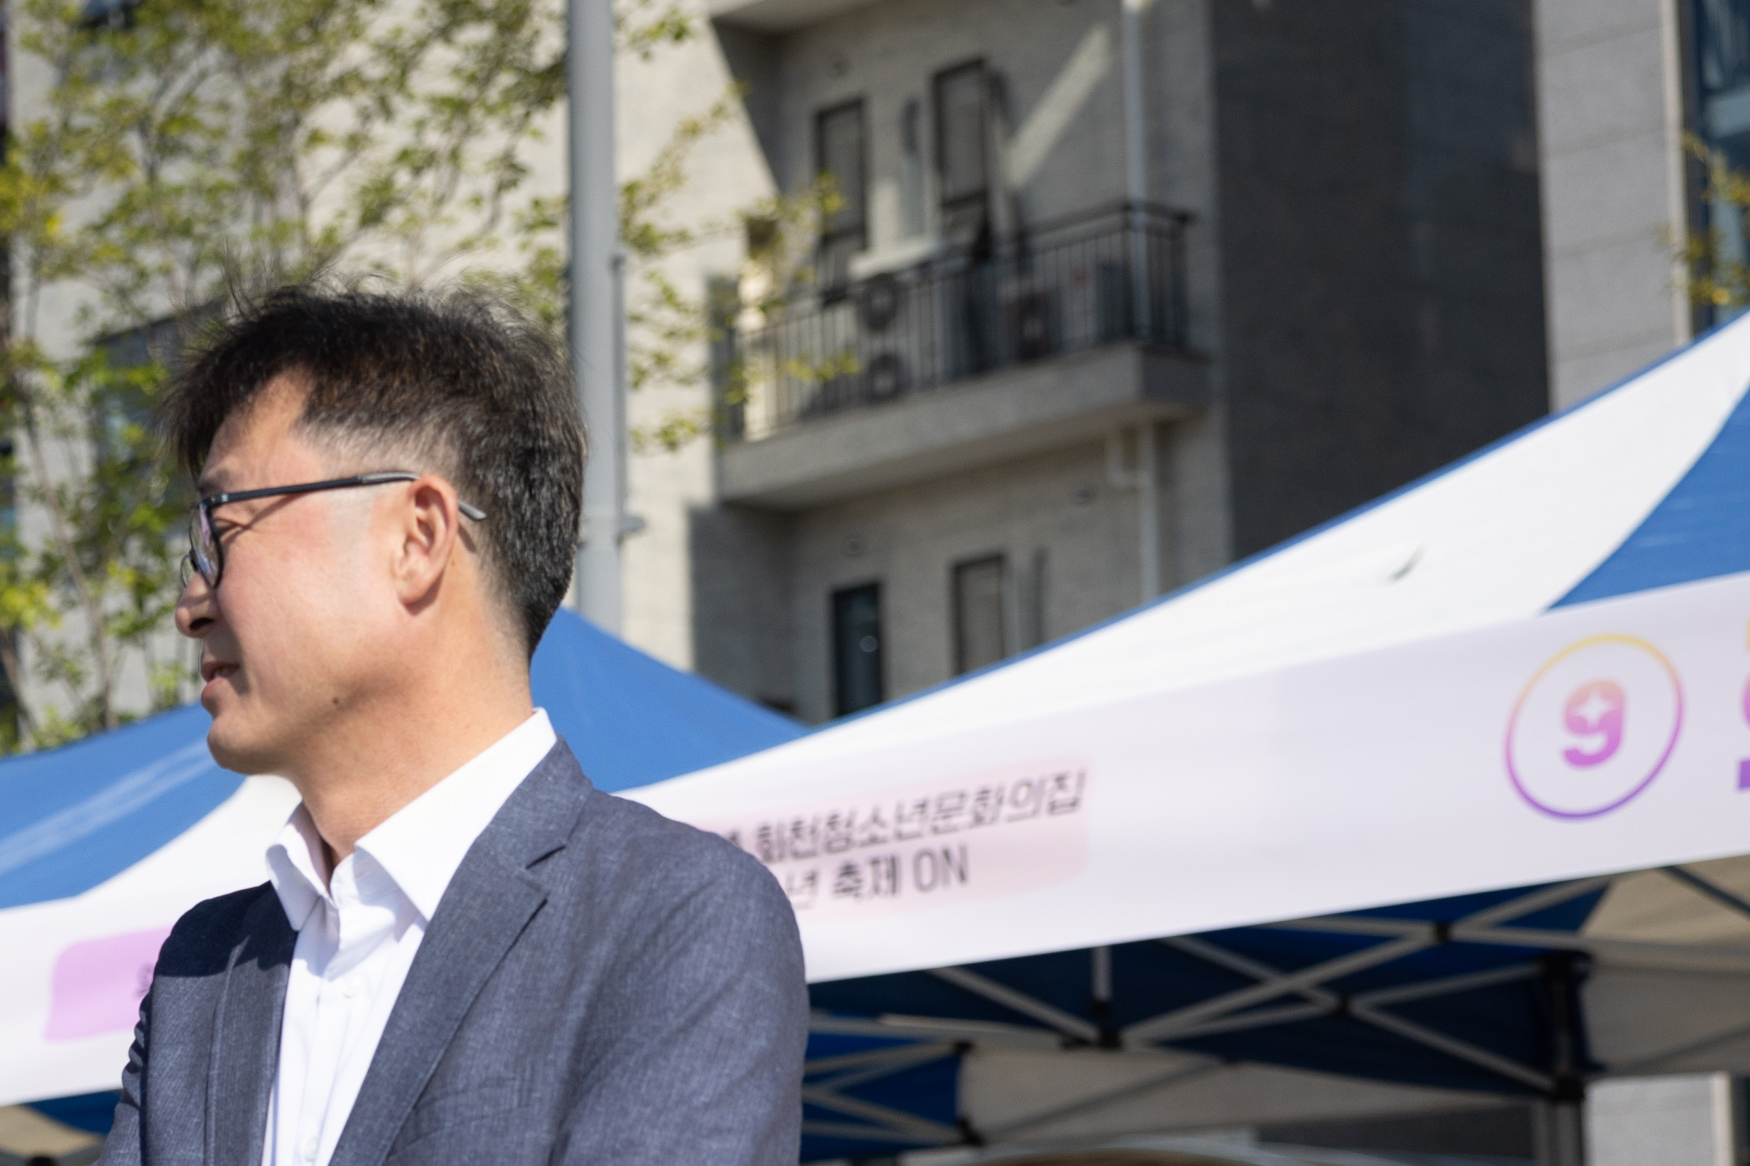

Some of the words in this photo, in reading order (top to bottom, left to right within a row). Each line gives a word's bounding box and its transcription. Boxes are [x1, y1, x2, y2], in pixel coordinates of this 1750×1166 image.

[1562, 679, 1627, 769] 9
[832, 851, 901, 902] 축제
[912, 842, 970, 894] ON
